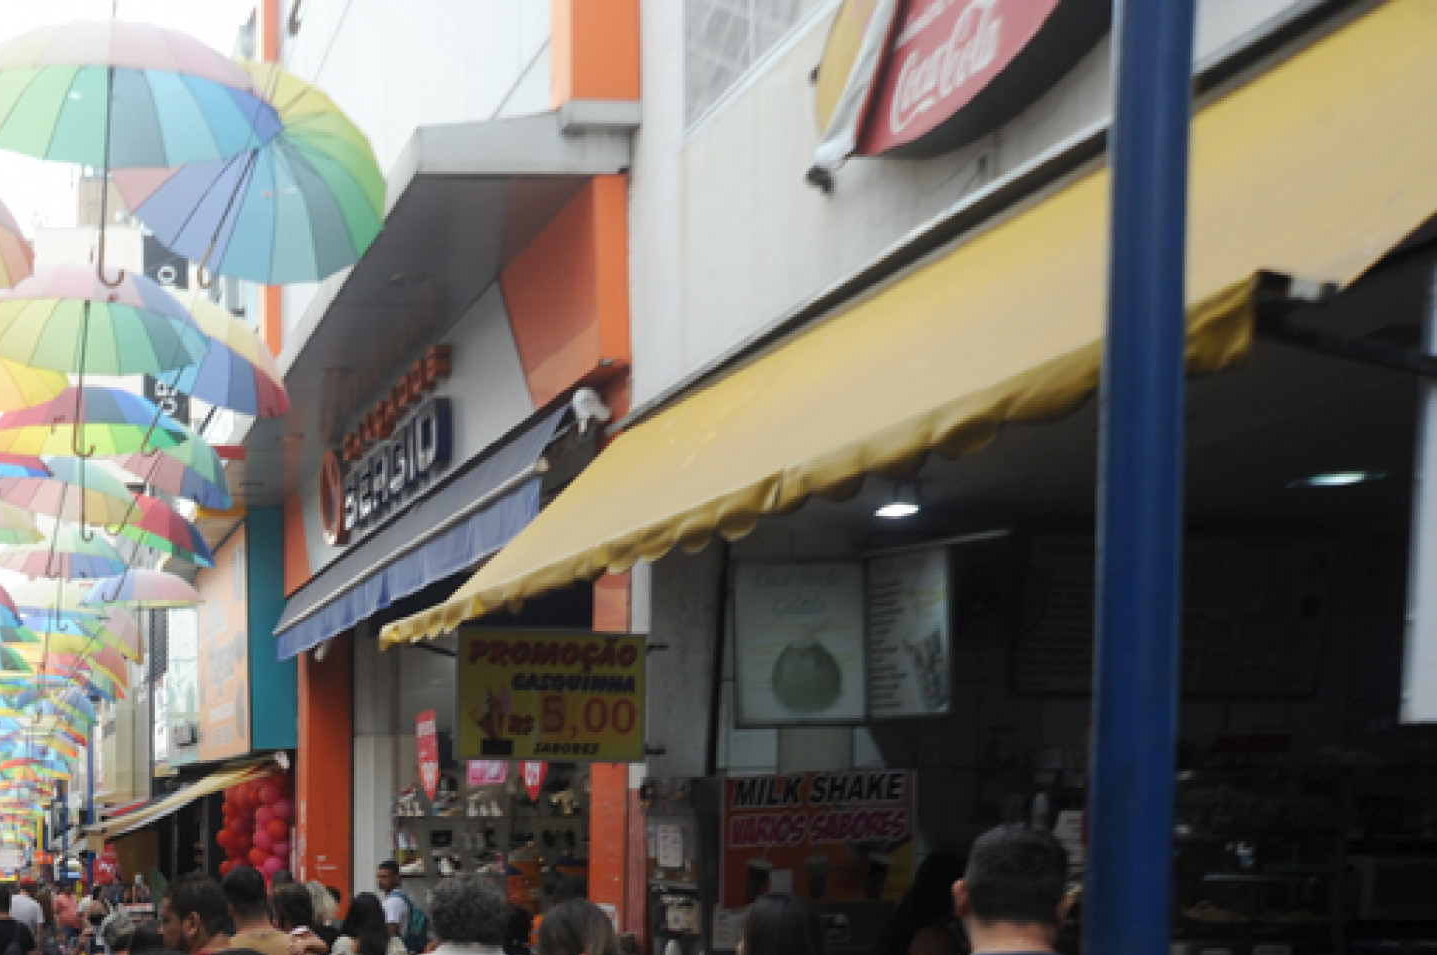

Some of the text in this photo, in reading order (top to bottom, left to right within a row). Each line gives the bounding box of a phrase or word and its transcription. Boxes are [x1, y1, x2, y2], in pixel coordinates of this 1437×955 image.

[467, 636, 639, 674] PROMOÇÃO
[511, 672, 636, 693] CASQUINHA
[540, 695, 636, 739] 5,00
[734, 773, 906, 807] MILK SHAKE
[810, 808, 907, 844] SABORES
